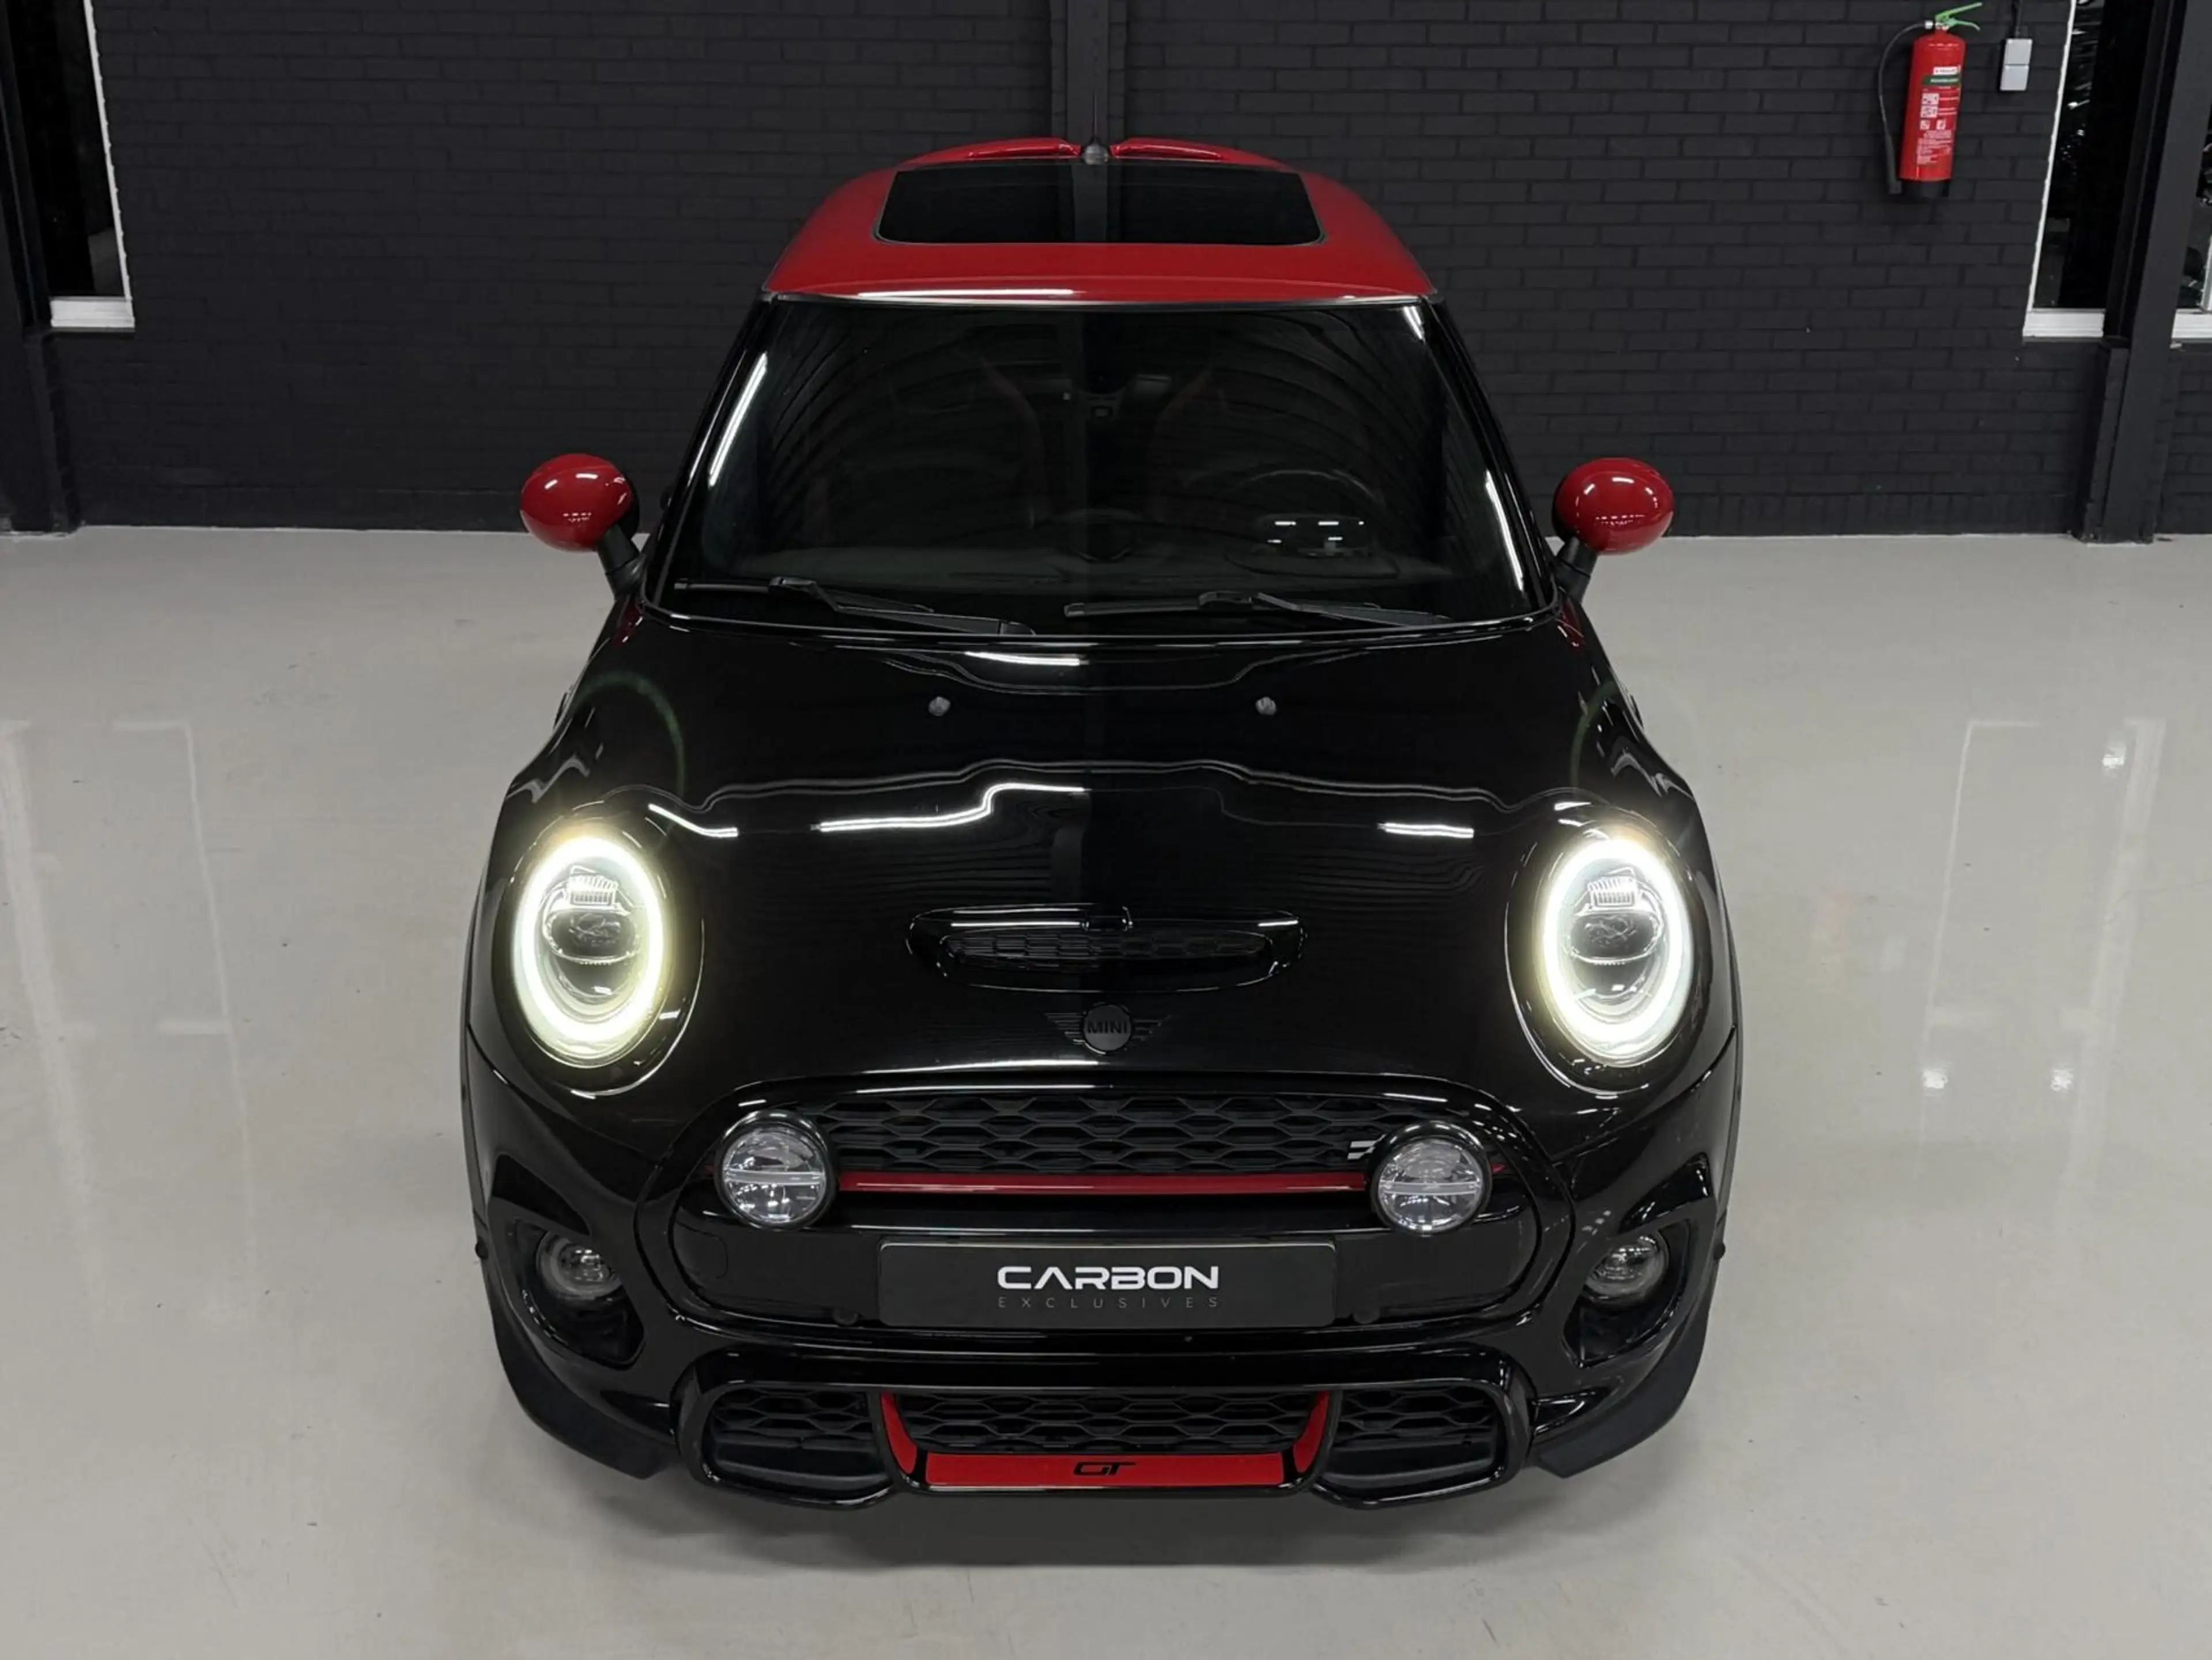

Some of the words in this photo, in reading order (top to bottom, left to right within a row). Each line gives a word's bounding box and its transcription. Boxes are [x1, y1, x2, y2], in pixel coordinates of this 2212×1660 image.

[1087, 1020, 1128, 1034] MINI
[998, 1266, 1219, 1290] CARBON
[998, 1297, 1218, 1308] EXCLUSIVES
[1073, 1461, 1137, 1476] GT
